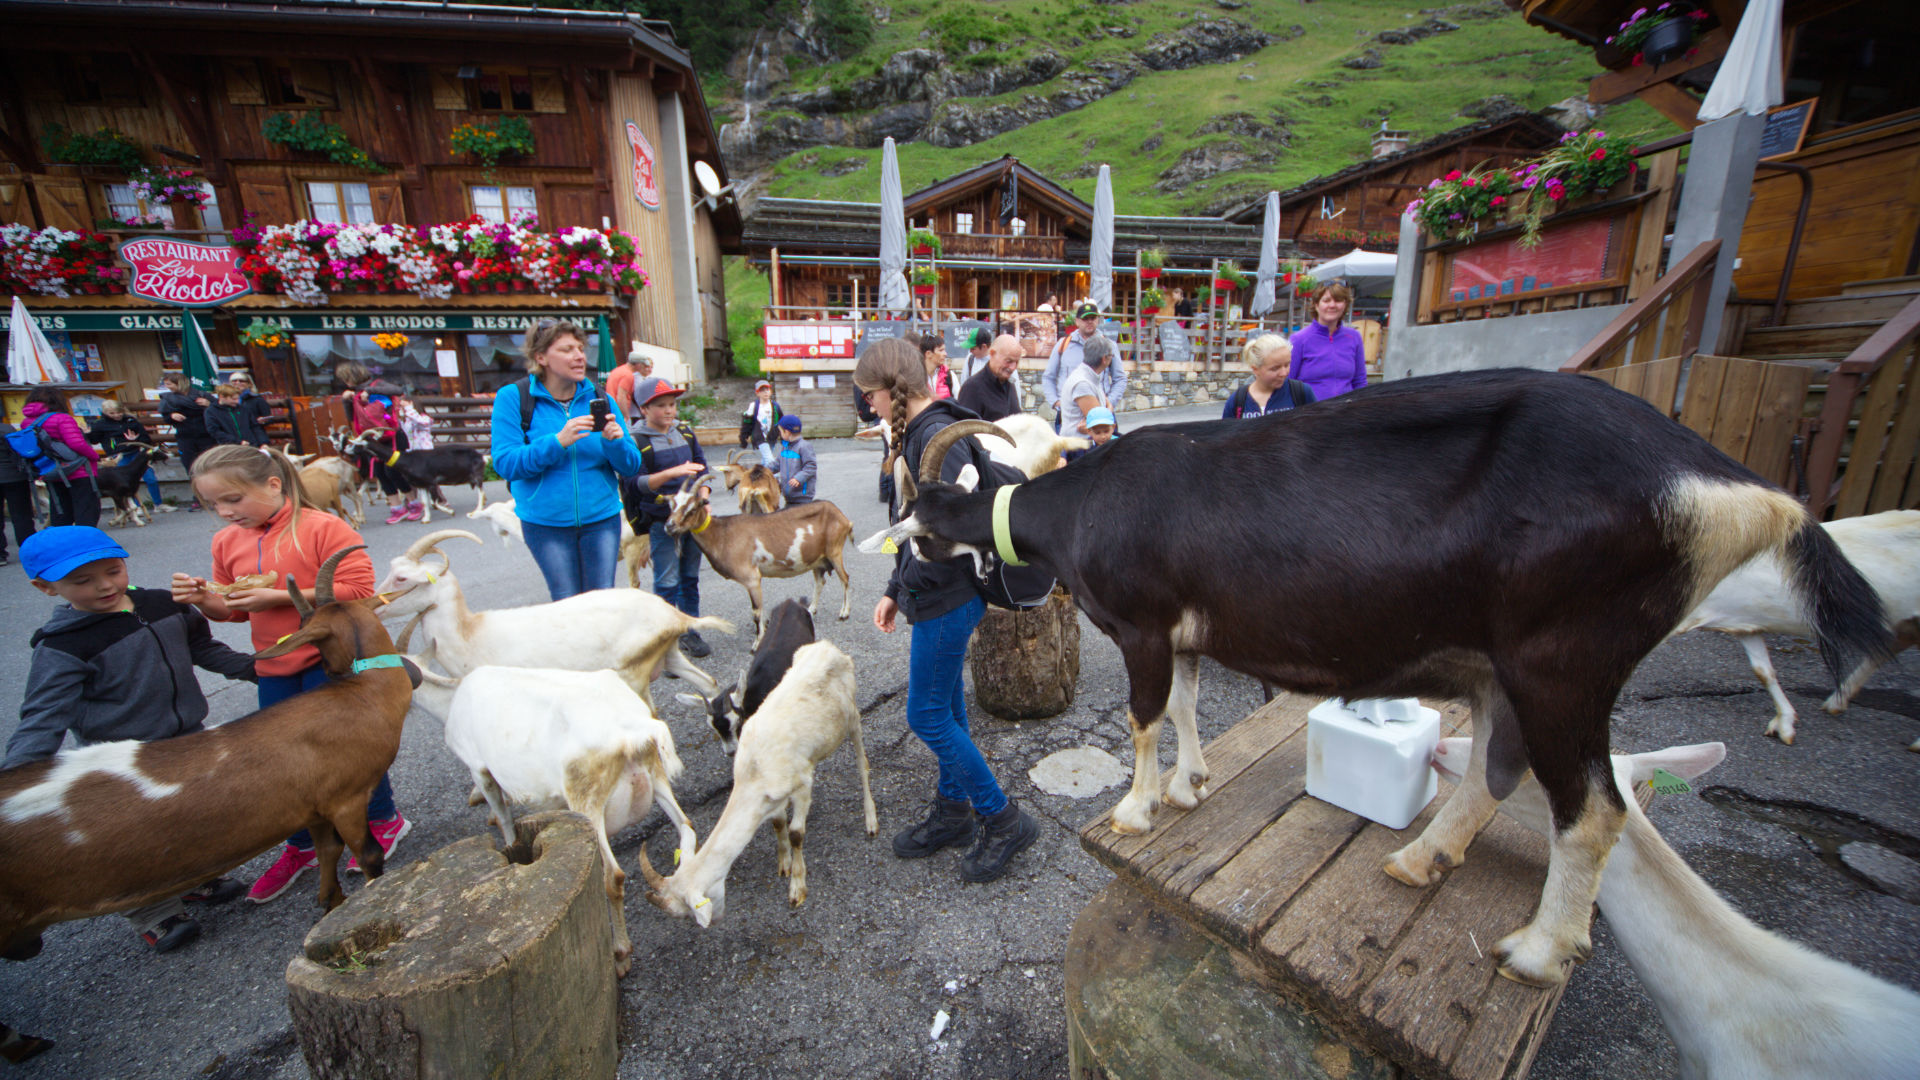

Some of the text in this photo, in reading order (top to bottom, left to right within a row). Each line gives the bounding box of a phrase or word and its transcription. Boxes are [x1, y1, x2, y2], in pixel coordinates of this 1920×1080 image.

[126, 241, 231, 263] RESTAURANT
[147, 258, 202, 279] Les
[136, 272, 243, 300] Rhodos
[0, 315, 67, 329] RPES
[321, 315, 357, 329] LES
[369, 315, 446, 329] RHODOS
[471, 315, 596, 329] RESTANT
[1656, 783, 1689, 795] 50140
